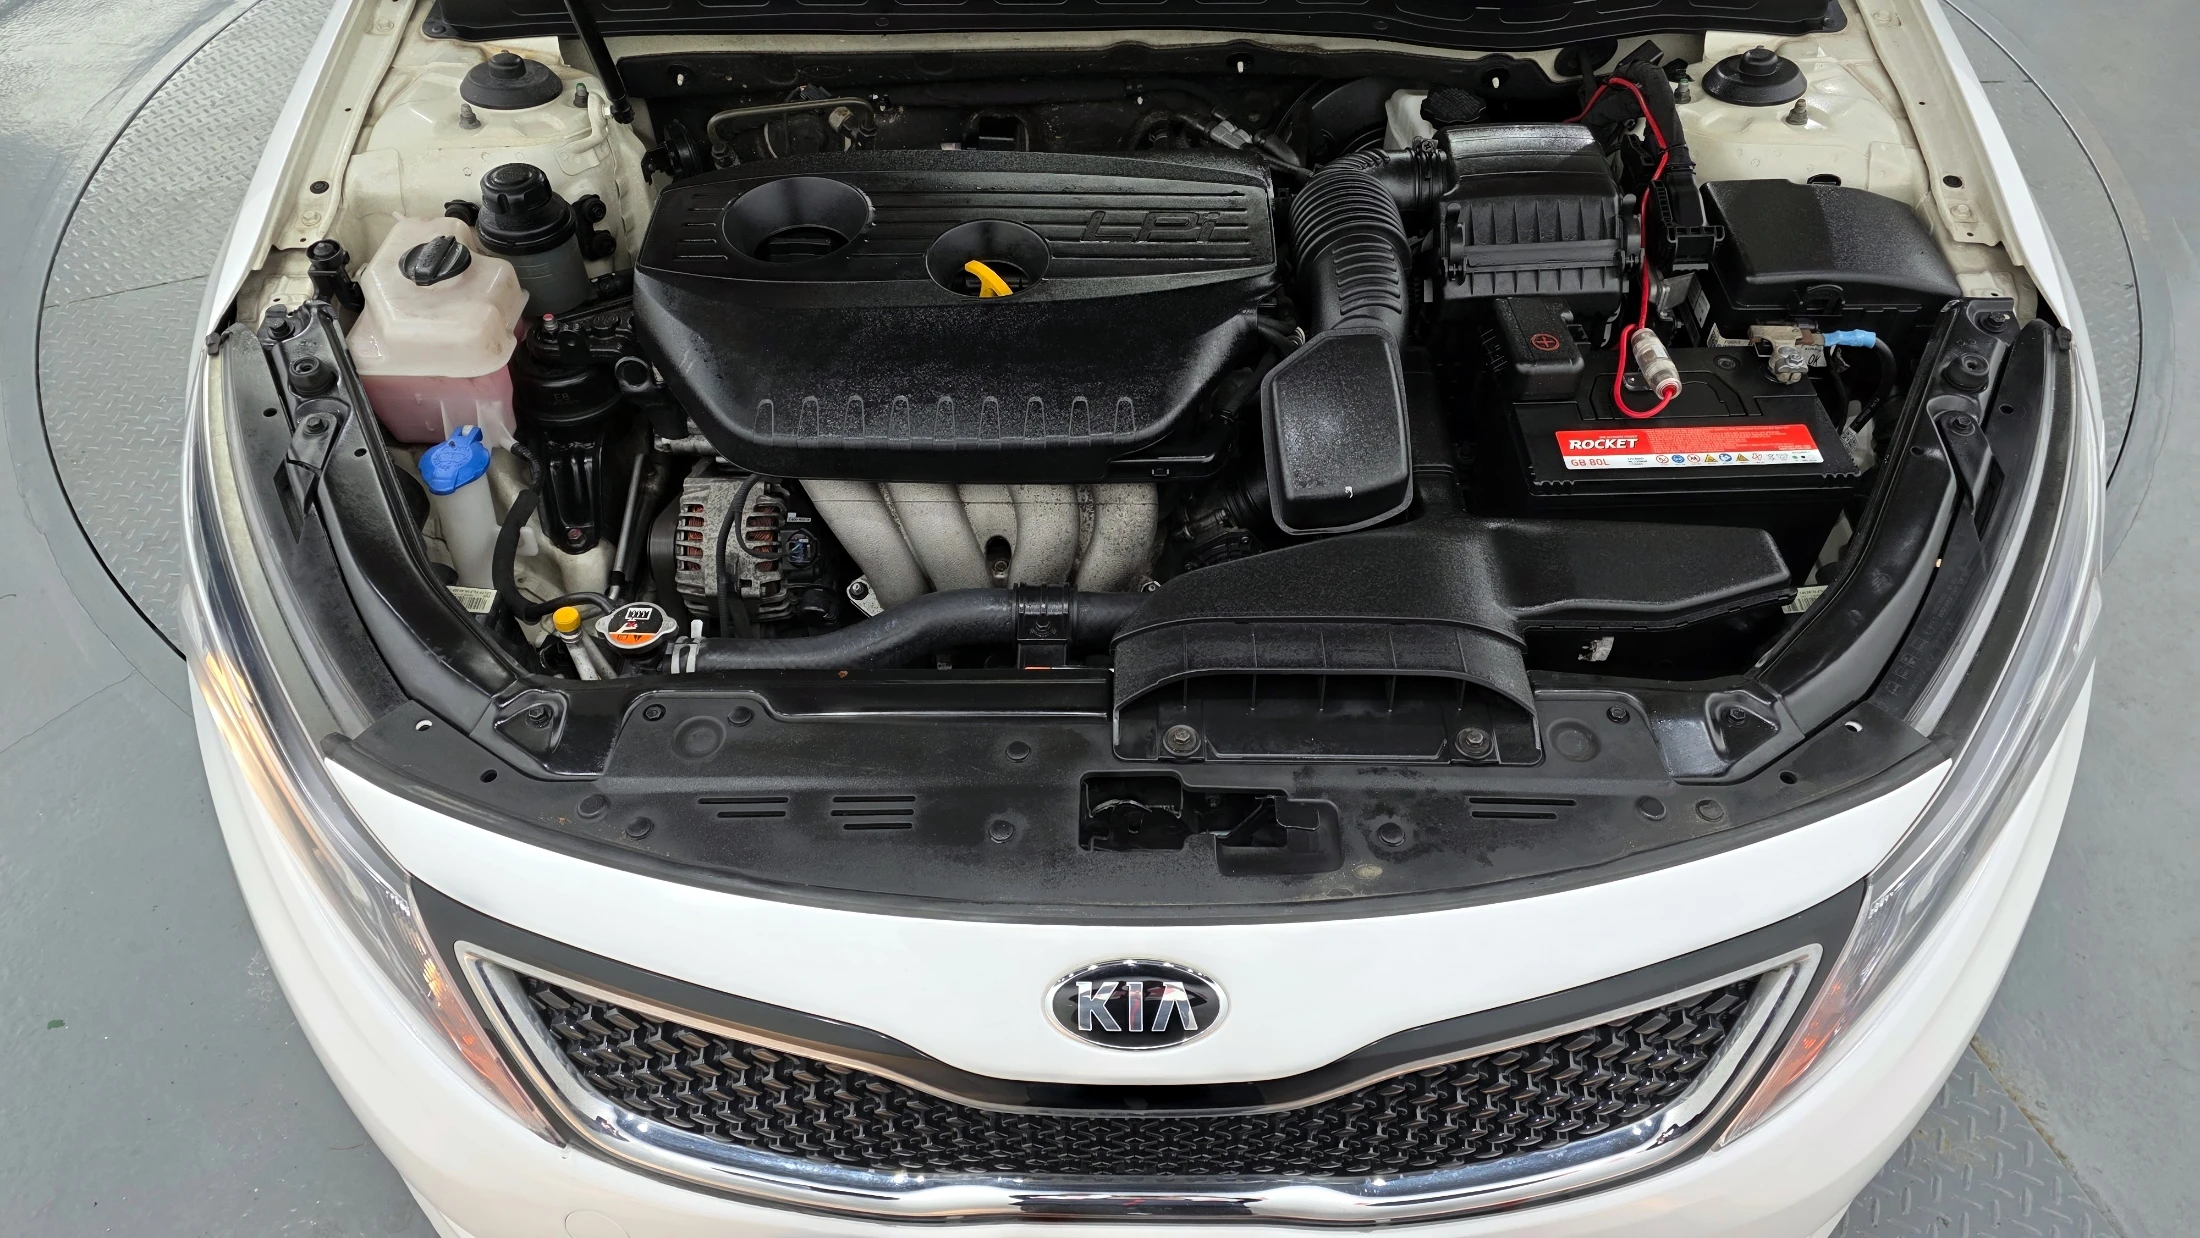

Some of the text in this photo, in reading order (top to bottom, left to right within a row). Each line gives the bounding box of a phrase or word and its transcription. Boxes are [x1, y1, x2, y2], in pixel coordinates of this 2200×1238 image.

[1807, 353, 1822, 367] OK
[1568, 438, 1639, 451] ROCKET
[1570, 458, 1610, 467] GB 80L
[1075, 981, 1199, 1033] KIA
